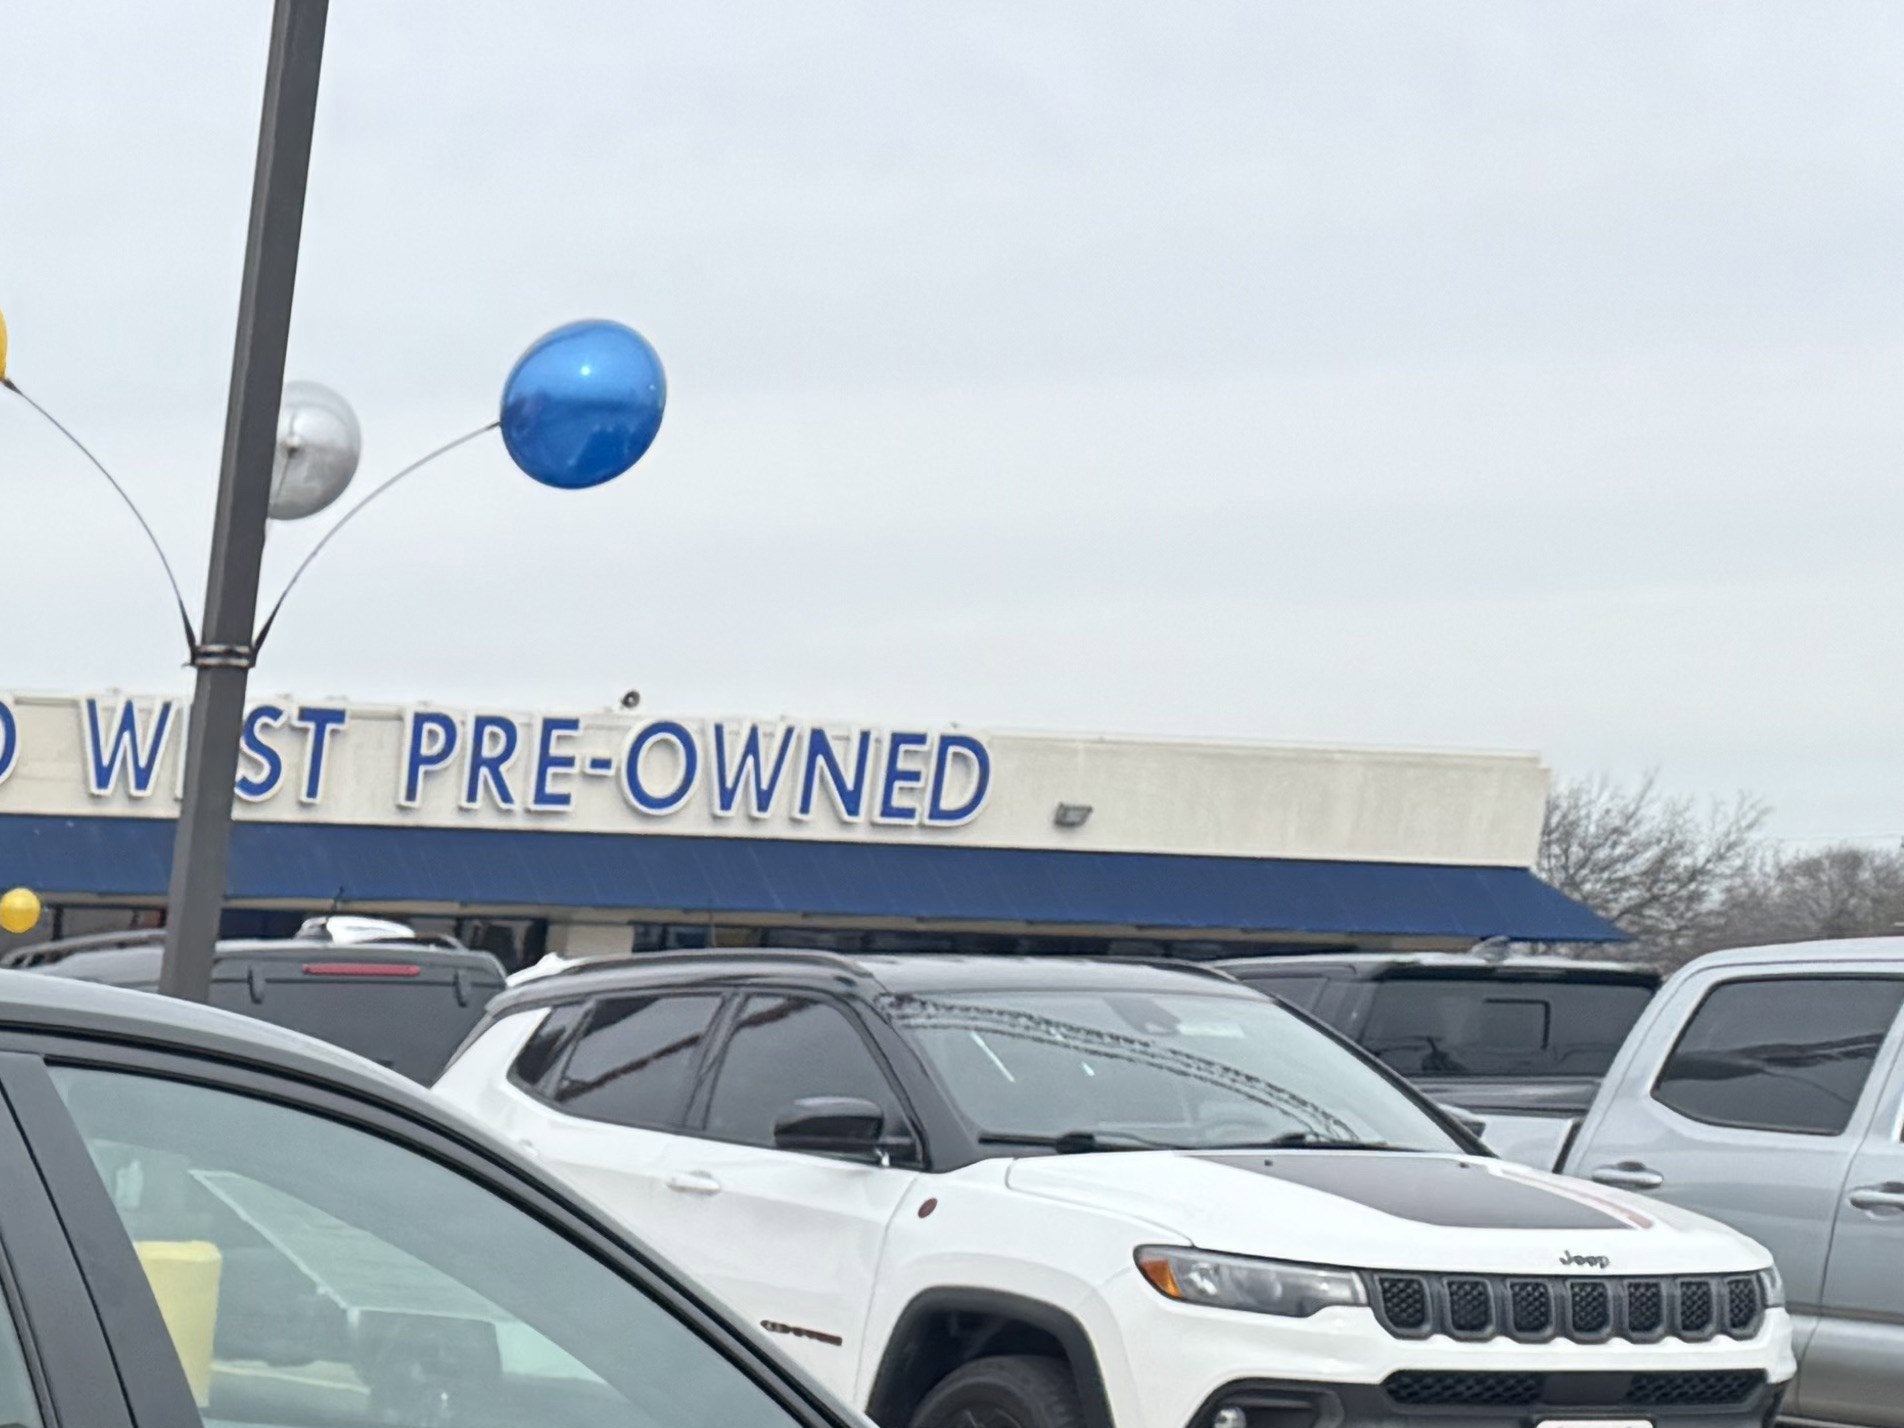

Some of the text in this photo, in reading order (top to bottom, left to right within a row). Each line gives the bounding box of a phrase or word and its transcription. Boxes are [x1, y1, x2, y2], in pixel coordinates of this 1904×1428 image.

[84, 696, 347, 805] WST
[401, 710, 993, 827] PRE-OWNED
[1558, 1249, 1610, 1269] Jeep
